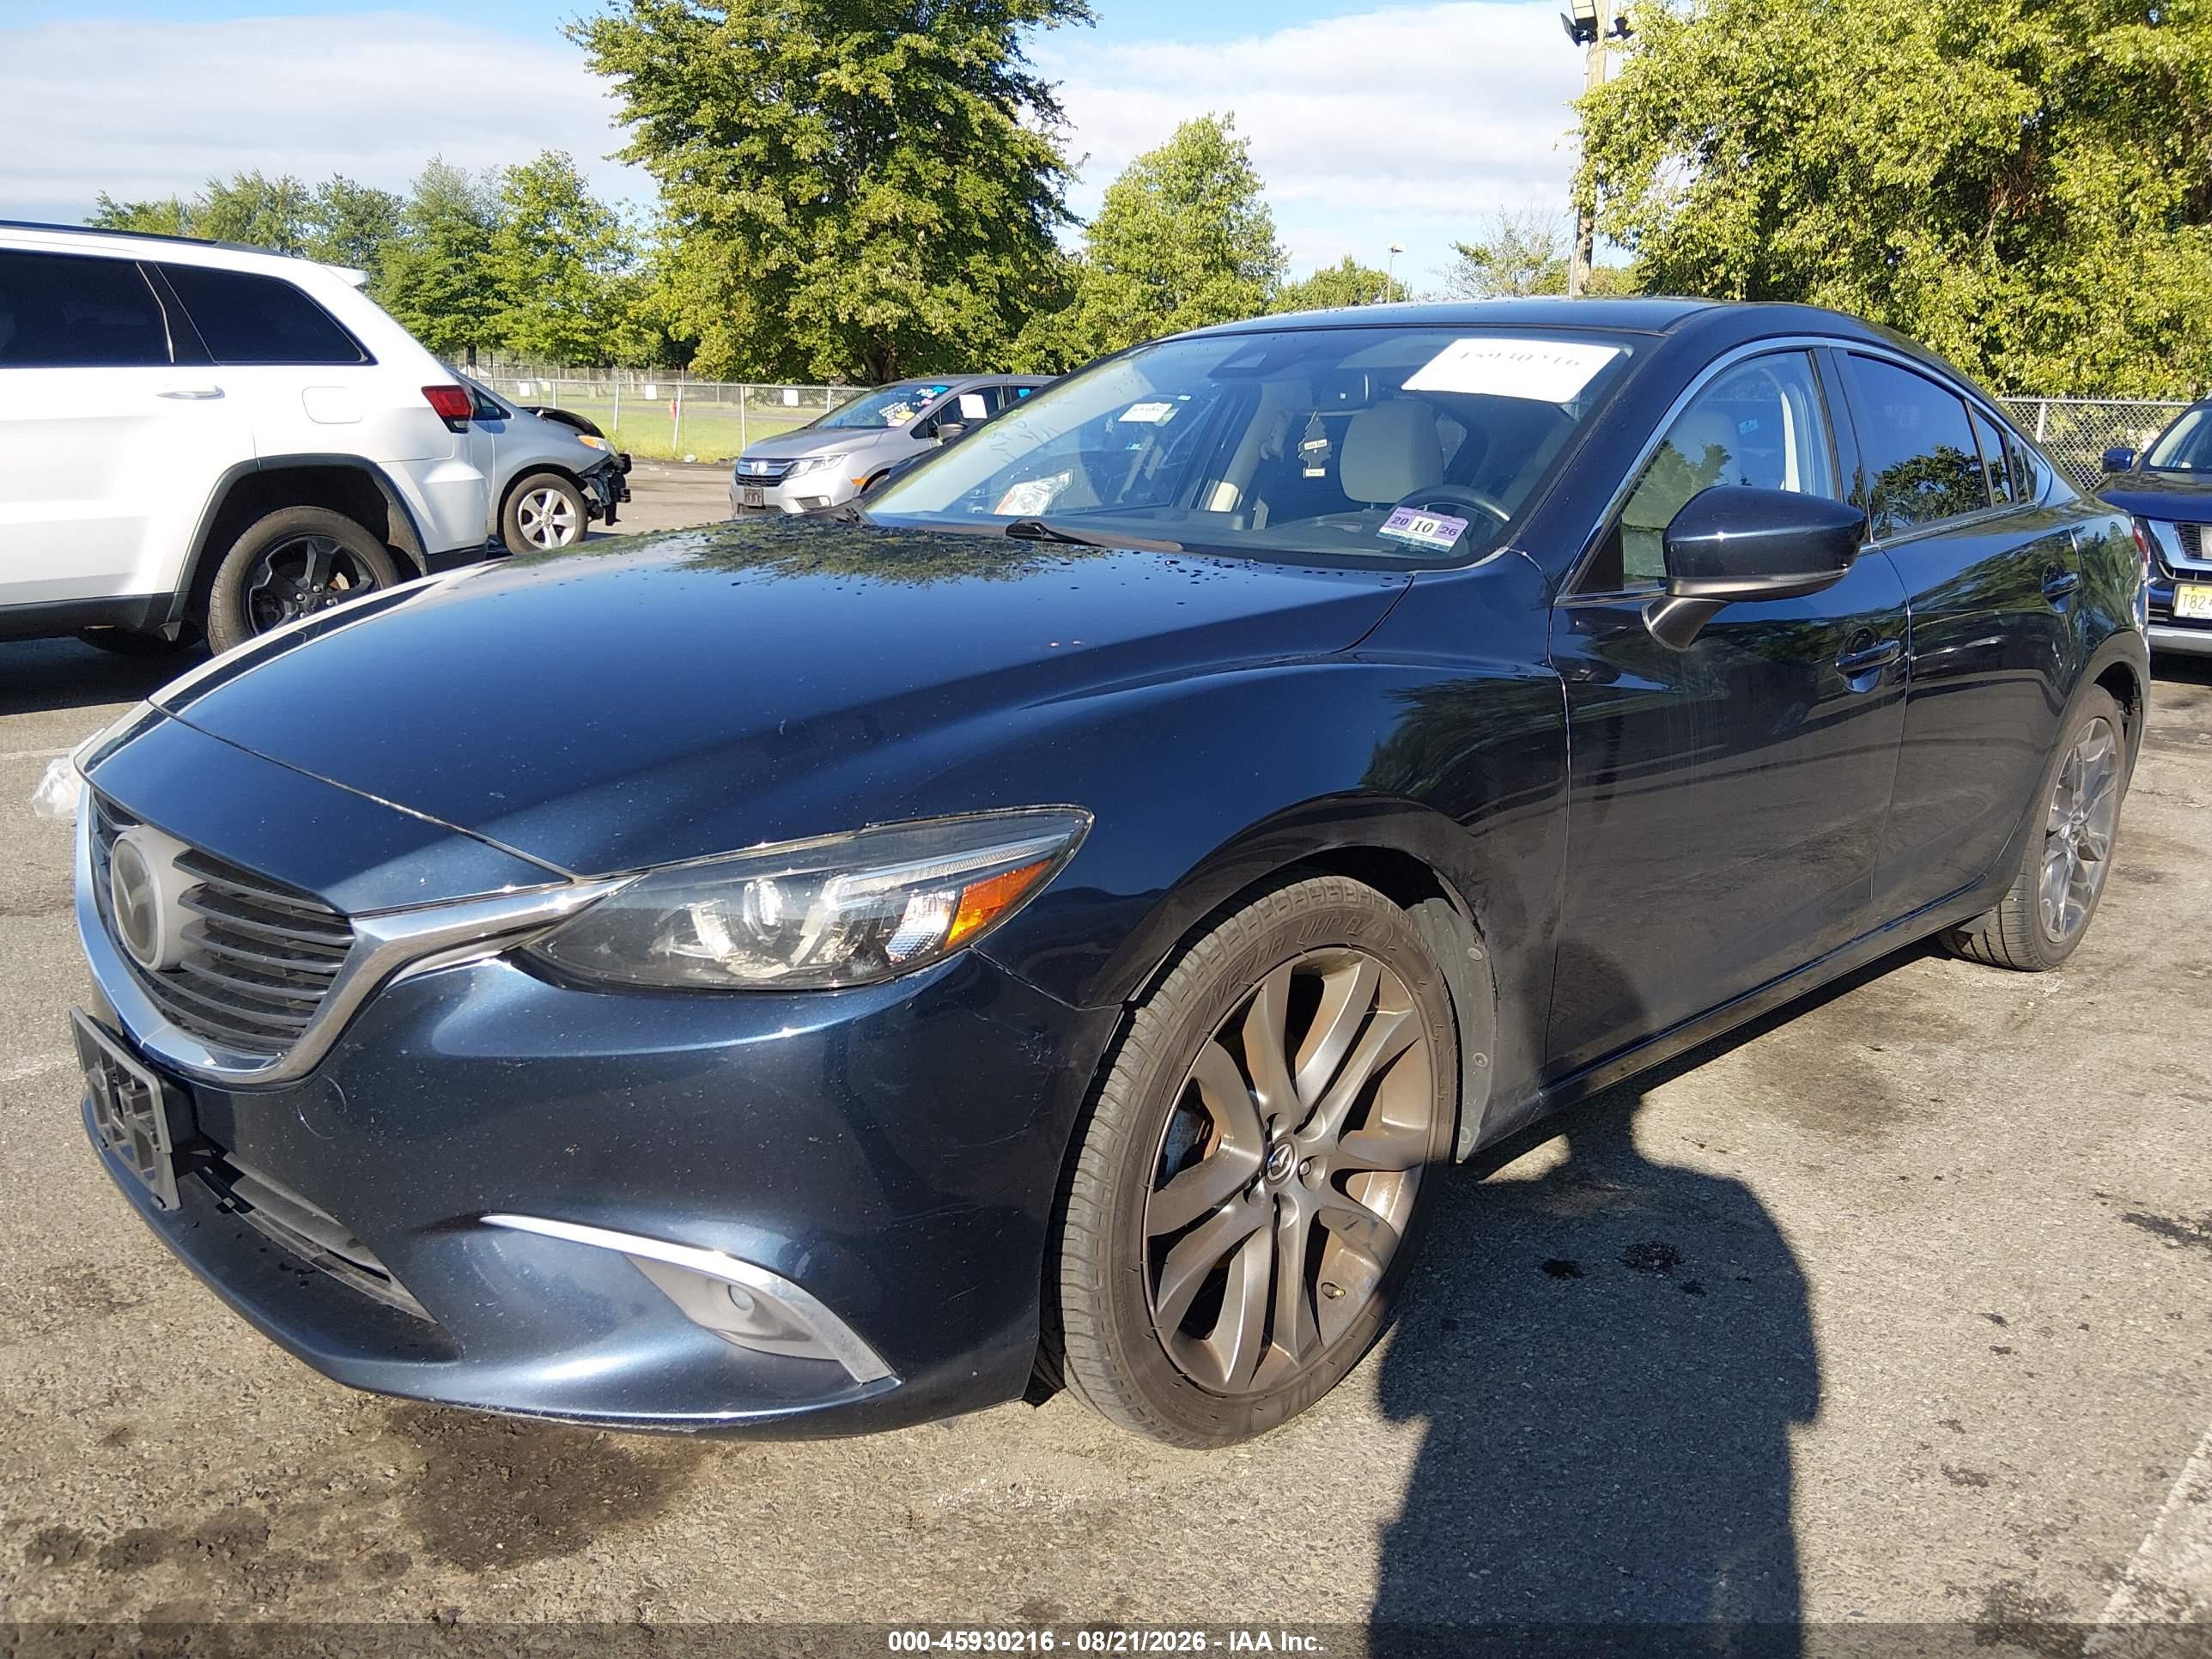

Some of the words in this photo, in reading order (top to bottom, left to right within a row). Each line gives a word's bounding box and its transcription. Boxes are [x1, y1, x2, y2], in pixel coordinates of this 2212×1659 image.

[1392, 516, 1409, 526] 20
[1412, 520, 1434, 533] 10
[1438, 526, 1459, 537] 26
[2184, 594, 2206, 610] T82
